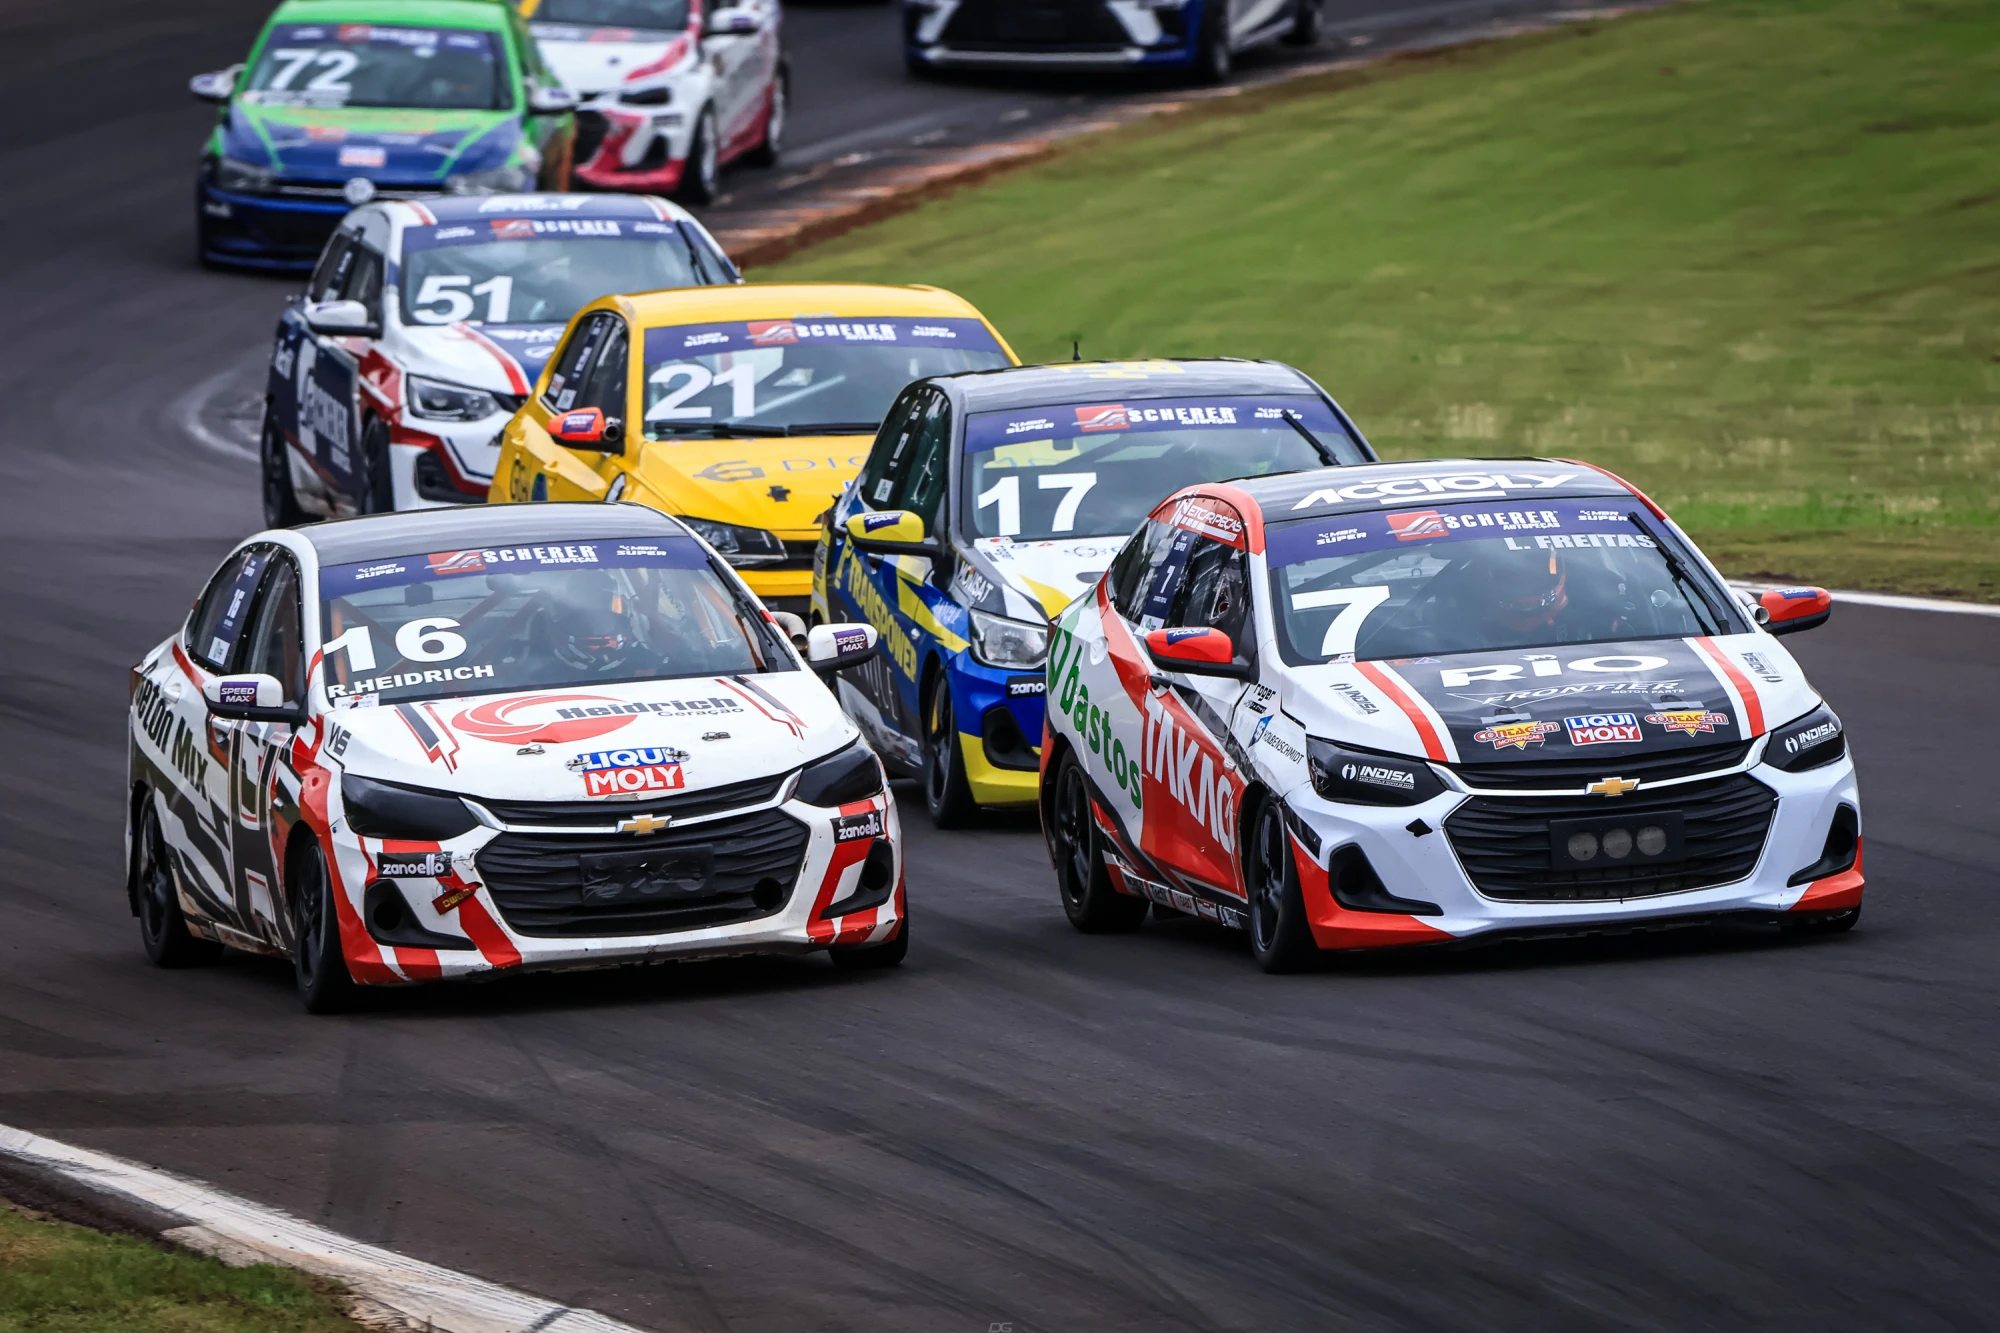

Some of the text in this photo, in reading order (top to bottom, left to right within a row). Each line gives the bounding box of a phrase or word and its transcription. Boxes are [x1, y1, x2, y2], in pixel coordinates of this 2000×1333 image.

[270, 49, 359, 91] 72
[412, 275, 513, 324] 51
[796, 324, 896, 337] SCHERER
[645, 363, 756, 422] 21
[1129, 406, 1236, 422] SCHERER
[1005, 422, 1055, 435] SUPER
[1291, 474, 1579, 511] ACCIOLY
[978, 472, 1097, 537] 17
[1443, 510, 1558, 530] SCHERER
[1503, 521, 1561, 531] AUTOPEÇAS
[1578, 514, 1628, 522] SUPER
[1316, 532, 1367, 545] SUPER
[1329, 528, 1359, 538] MBR
[1504, 534, 1658, 551] L. FREITAS
[483, 545, 598, 564] SCHERER
[540, 556, 599, 565] AUTOPEÇAS
[616, 549, 667, 557] SUPER
[355, 566, 406, 580] SUPER
[370, 562, 399, 572] MBR
[847, 553, 918, 684] TRANSPOWER
[1291, 585, 1391, 657] 7
[321, 617, 467, 673] 16
[837, 634, 866, 646] SPEED
[842, 641, 863, 653] MAX
[327, 664, 495, 699] R.HEIDRICH
[1009, 682, 1045, 695] zano
[220, 687, 256, 695] SPEED
[225, 695, 251, 703] MAX
[1253, 684, 1276, 701] roger
[1482, 681, 1681, 705] FRONTIER
[556, 697, 738, 719] Heidrich
[1345, 690, 1380, 715] INDISA
[657, 707, 745, 717] Geração
[1060, 645, 1142, 810] bastos
[1570, 714, 1633, 729] LIQUI
[1668, 723, 1711, 731] MOTORPEÇAS
[1499, 733, 1541, 746] MOTORPEÇAS
[1575, 726, 1638, 741] MOLY
[1798, 722, 1837, 744] INDISA
[586, 748, 674, 771] LIQUI
[588, 766, 681, 795] MOLY
[1145, 689, 1236, 856] TAKAO
[1360, 765, 1415, 784] INDISA
[838, 813, 880, 840] zanoello
[382, 853, 445, 876] zanoello
